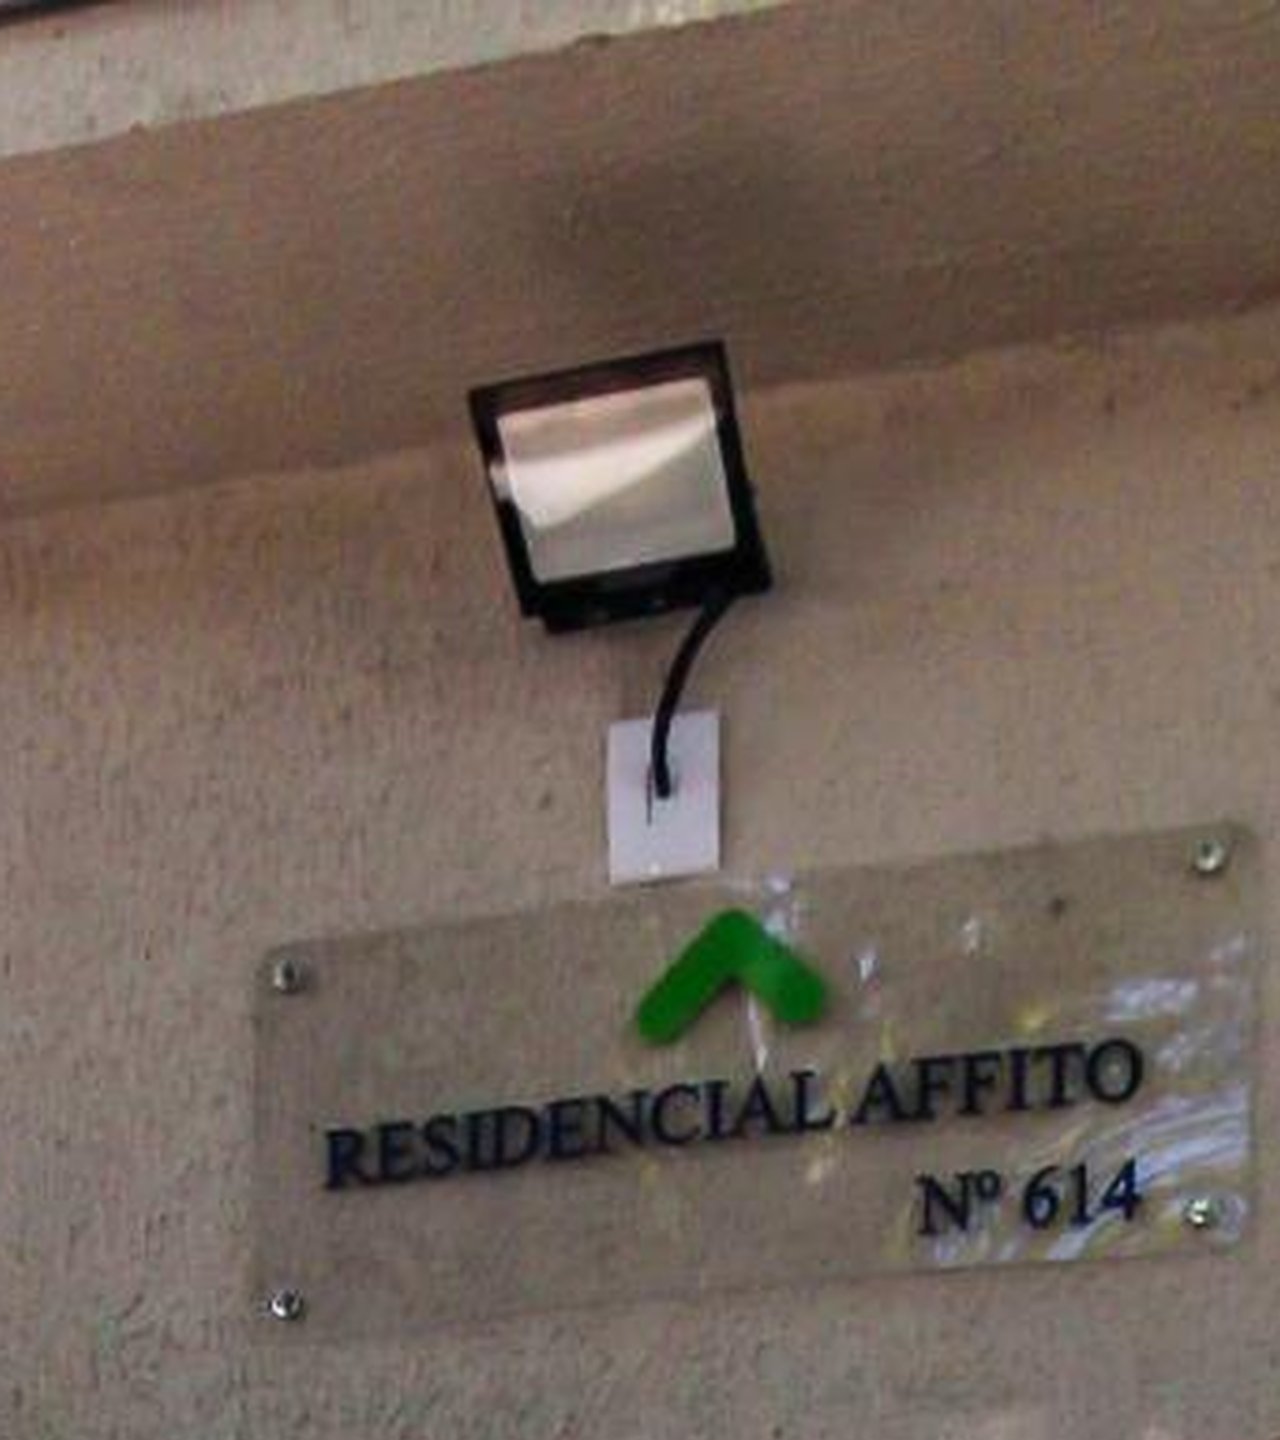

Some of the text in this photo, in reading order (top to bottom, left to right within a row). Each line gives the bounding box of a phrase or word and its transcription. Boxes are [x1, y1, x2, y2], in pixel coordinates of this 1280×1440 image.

[323, 1036, 1146, 1192] RESIDENCIAL AFFITO
[1024, 1156, 1143, 1230] 614
